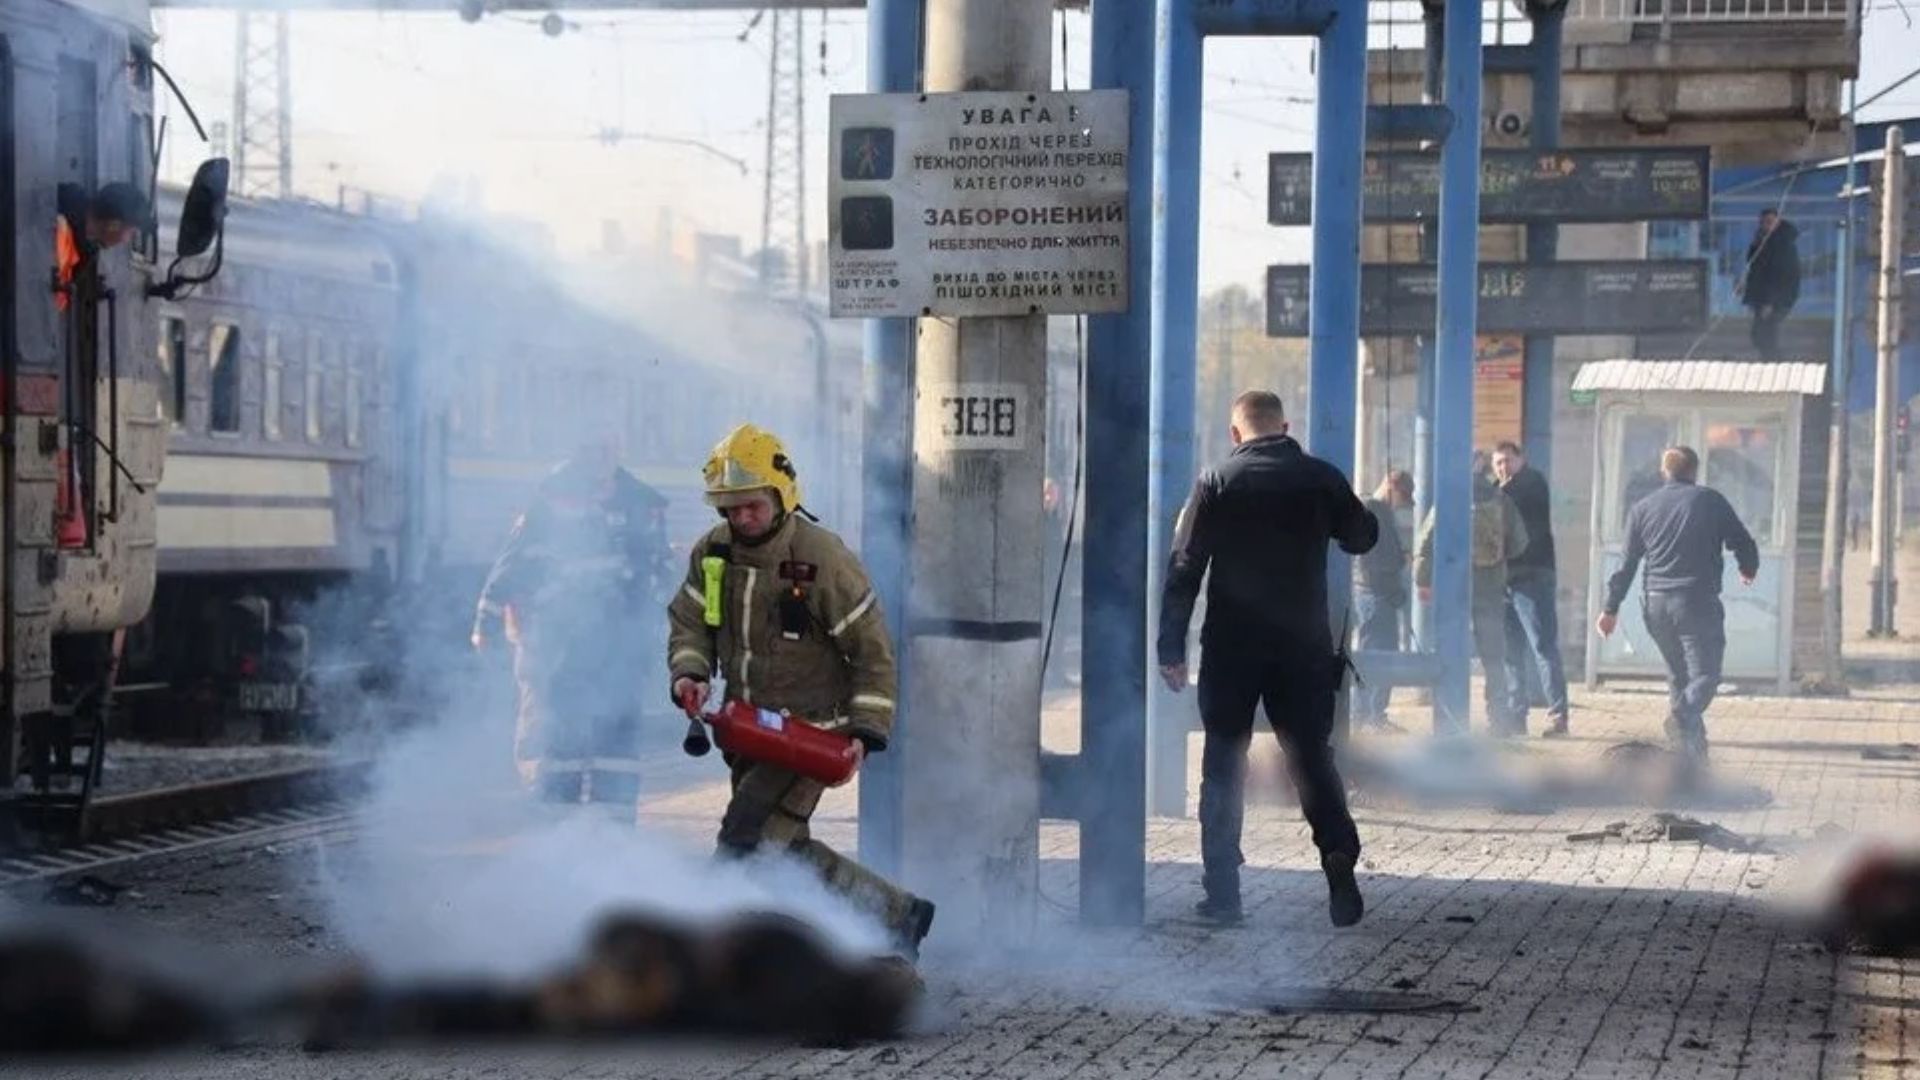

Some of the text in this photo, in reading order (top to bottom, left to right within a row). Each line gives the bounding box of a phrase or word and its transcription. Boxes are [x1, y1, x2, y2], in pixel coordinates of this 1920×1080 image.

[962, 108, 1052, 125] УВАГА
[949, 134, 1093, 151] ПРОХІД ЧЕРЕЗ
[914, 152, 1123, 170] ТЕХНОЛОГІЧНИЙ ПЕРЕХІД
[953, 175, 1085, 190] КАТЕГОРИЧНО
[924, 202, 1123, 226] ЗАБОРОНЕНИЙ
[929, 237, 1027, 251] НЕБЕЗПЕЧНО
[1066, 235, 1120, 249] ЖИТТЯ
[835, 278, 900, 289] ШТРАФ
[933, 272, 979, 284] ВИХІД
[986, 272, 1007, 284] ДО
[1013, 271, 1060, 282] МІСТА
[936, 283, 1063, 299] ПІШОХІДНИЙ
[941, 396, 1016, 437] 388
